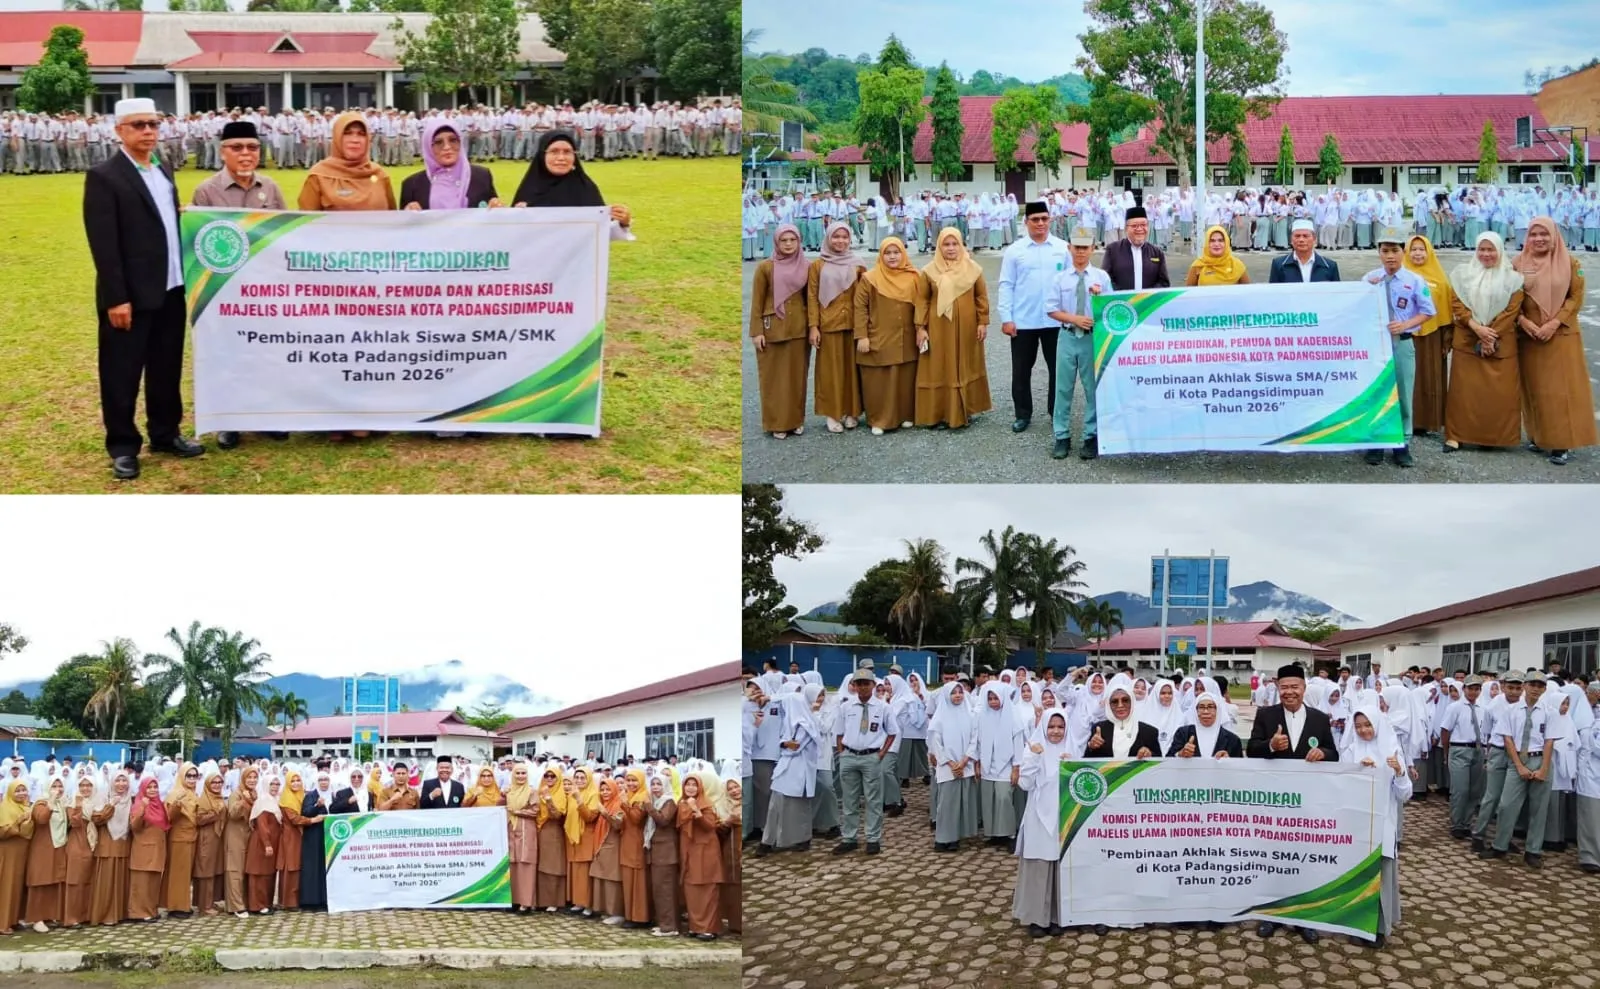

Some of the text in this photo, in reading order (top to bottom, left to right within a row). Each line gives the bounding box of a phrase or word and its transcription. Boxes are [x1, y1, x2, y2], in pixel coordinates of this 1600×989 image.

[286, 250, 510, 272] TIM SAFARI PENDIDIKAN
[241, 282, 553, 298] KOMISI PENDIDIKAN, PEMUDA DAN KADERISASI
[219, 301, 573, 317] MAJELIS ULAMA INDONESIA KOTA PADANGSIDIMPUAN
[1162, 312, 1318, 331] TIM SAFARI PENDIDIKAN
[351, 329, 410, 343] Akhlak
[416, 329, 467, 343] Siswa
[471, 328, 556, 343] SMA/SMK
[1132, 336, 1352, 351] KOMISI PENDIDIKAN, PEMUDA DAN KADERISASI
[287, 349, 507, 364] di Kota Padangsidimpuan
[1118, 350, 1368, 366] MAJELIS ULAMA INDONESIA KOTA PADANGSIDIMPUAN
[342, 368, 395, 382] Tahun
[1208, 373, 1251, 383] Akhlak
[1255, 371, 1292, 382] Siswa
[1296, 370, 1358, 382] SMA/SMK
[1164, 386, 1324, 399] di Kota Padangsidimpuan
[1204, 403, 1243, 413] Tahun
[1133, 788, 1302, 807] TIM SAFARI PENDIDIKAN
[1102, 813, 1336, 829] KOMISI PENDIDIKAN, PEMUDA DAN KADERISASI
[1088, 827, 1352, 844] MAJELIS ULAMA INDONESIA KOTA PADANGSIDIMPUAN
[1182, 847, 1226, 858] Akhlak
[1230, 848, 1267, 859] Siswa
[1271, 851, 1338, 865] SMA/SMK
[1136, 861, 1299, 876] di Kota Padangsidimpuan
[1176, 876, 1215, 886] Tahun
